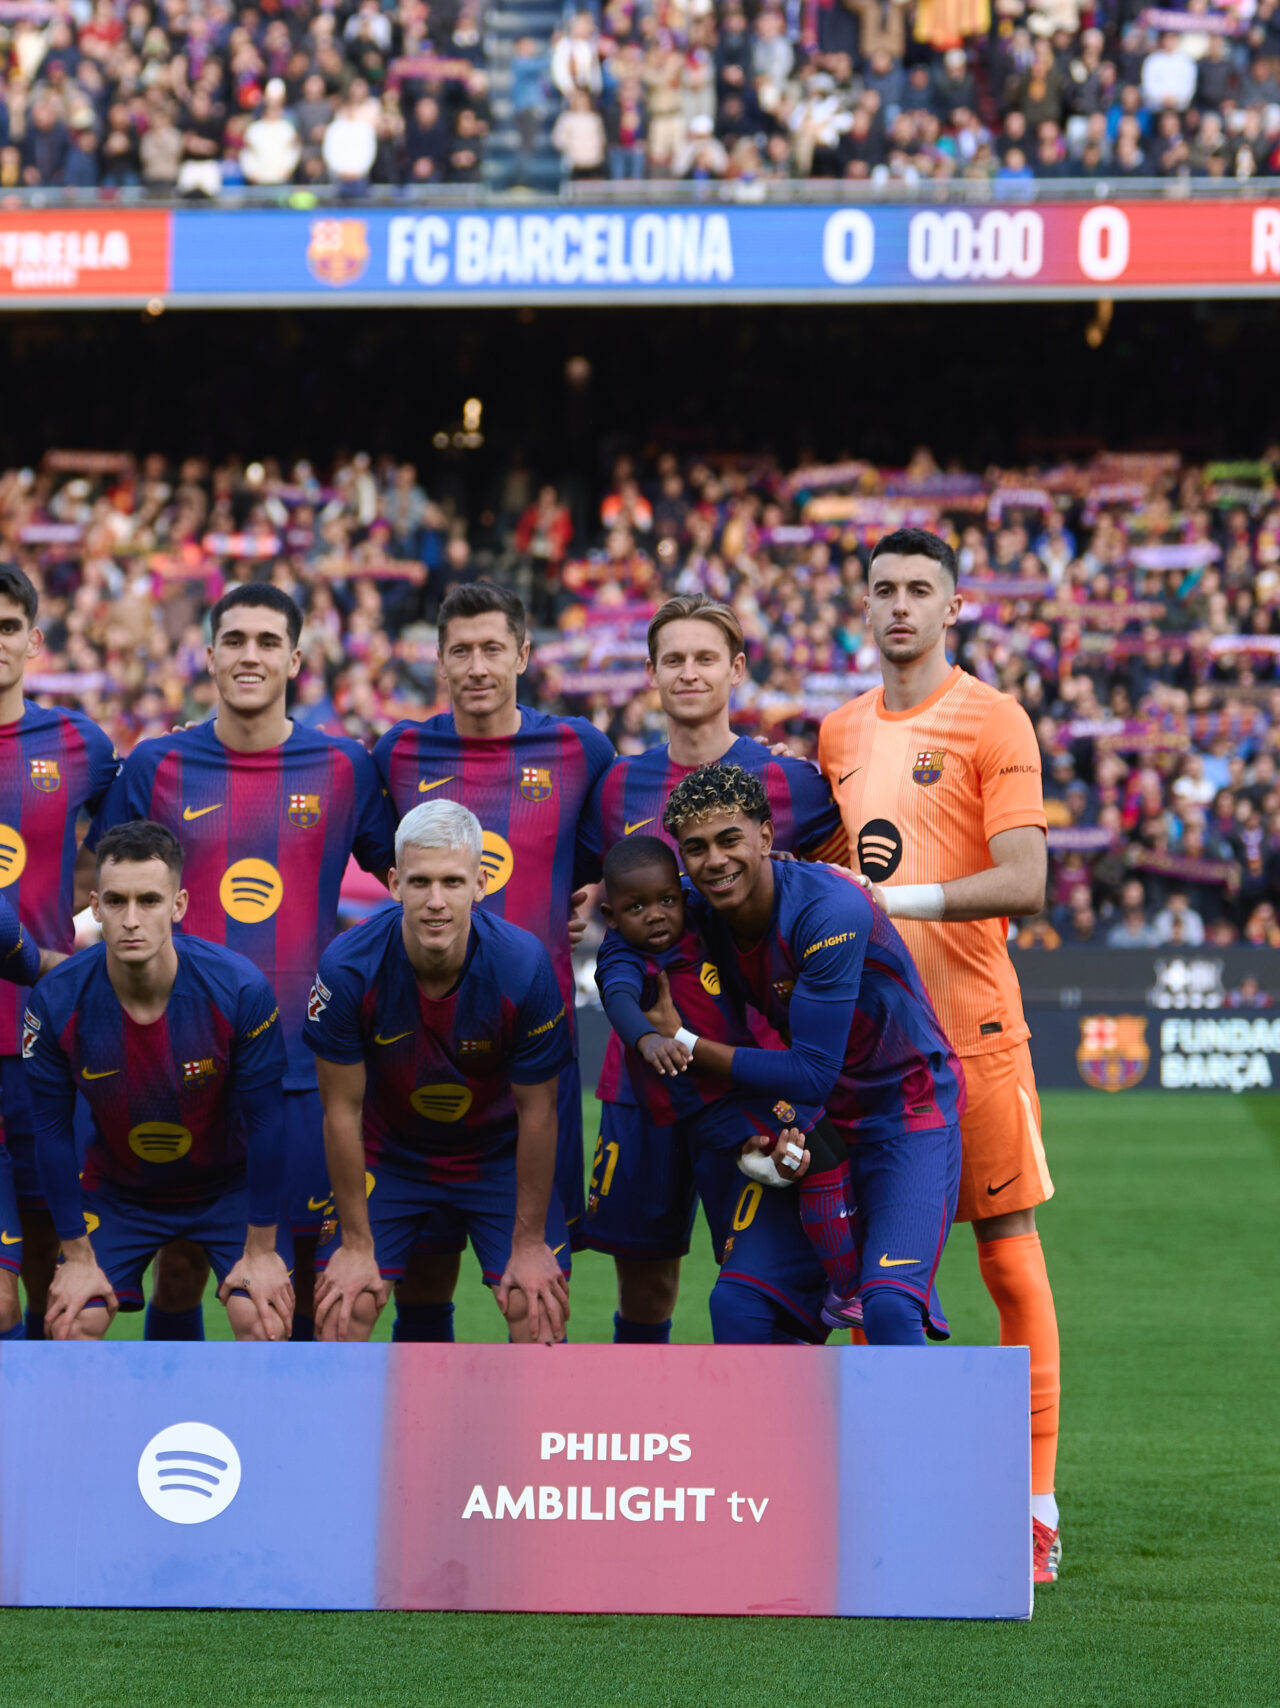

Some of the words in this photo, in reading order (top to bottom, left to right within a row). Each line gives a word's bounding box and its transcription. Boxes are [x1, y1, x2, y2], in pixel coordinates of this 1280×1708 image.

[387, 215, 450, 285] FC
[455, 213, 734, 284] BARCELONA
[822, 208, 875, 284] 0
[908, 209, 1044, 280] 00:00
[1078, 205, 1130, 281] 0
[1160, 1052, 1273, 1094] BARÇA
[540, 1432, 692, 1462] PHILIPS
[461, 1485, 716, 1522] AMBILIGHT
[726, 1491, 770, 1523] tv
